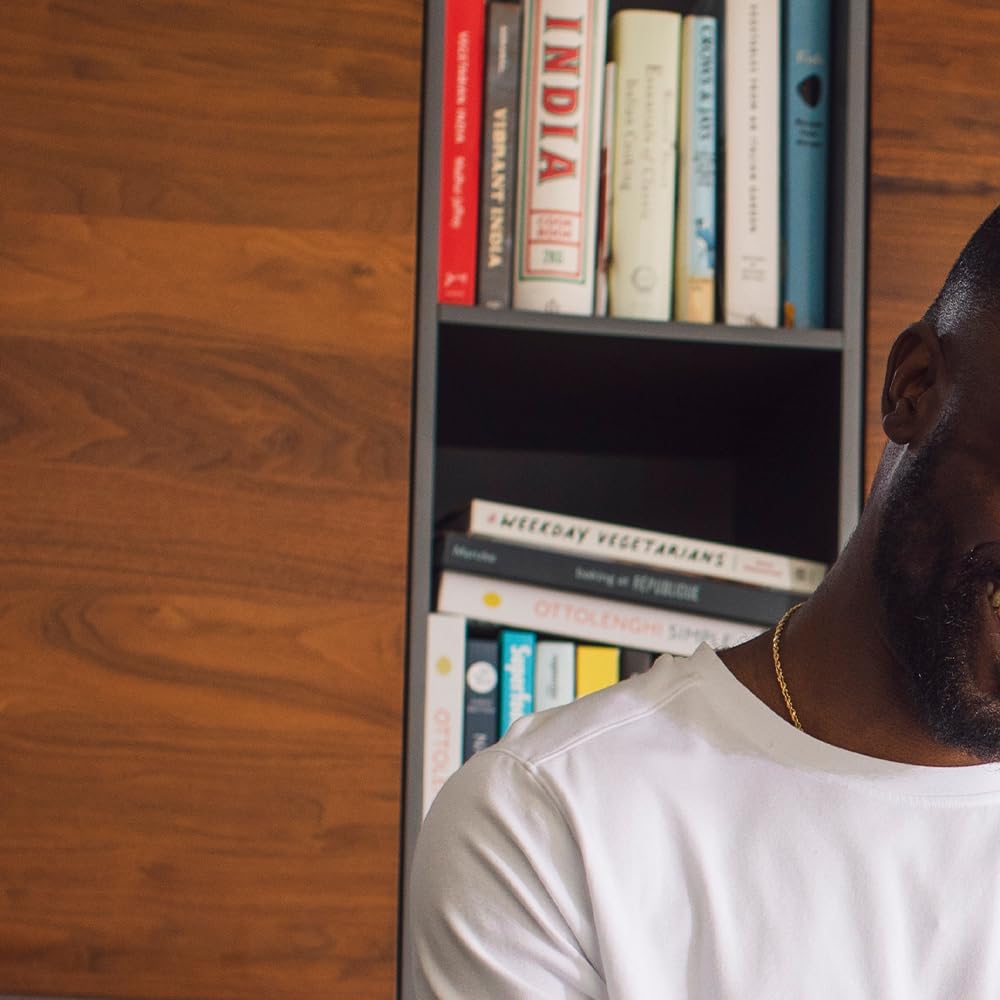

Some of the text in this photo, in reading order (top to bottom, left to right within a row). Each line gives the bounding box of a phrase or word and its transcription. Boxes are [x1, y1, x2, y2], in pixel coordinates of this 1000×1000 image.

[538, 16, 583, 186] INDIA
[488, 107, 508, 269] VIBRANT INDIA
[500, 514, 590, 545] WEEKDAY
[596, 530, 726, 568] VEGETARIANS
[533, 600, 665, 636] OTTOLENGHI
